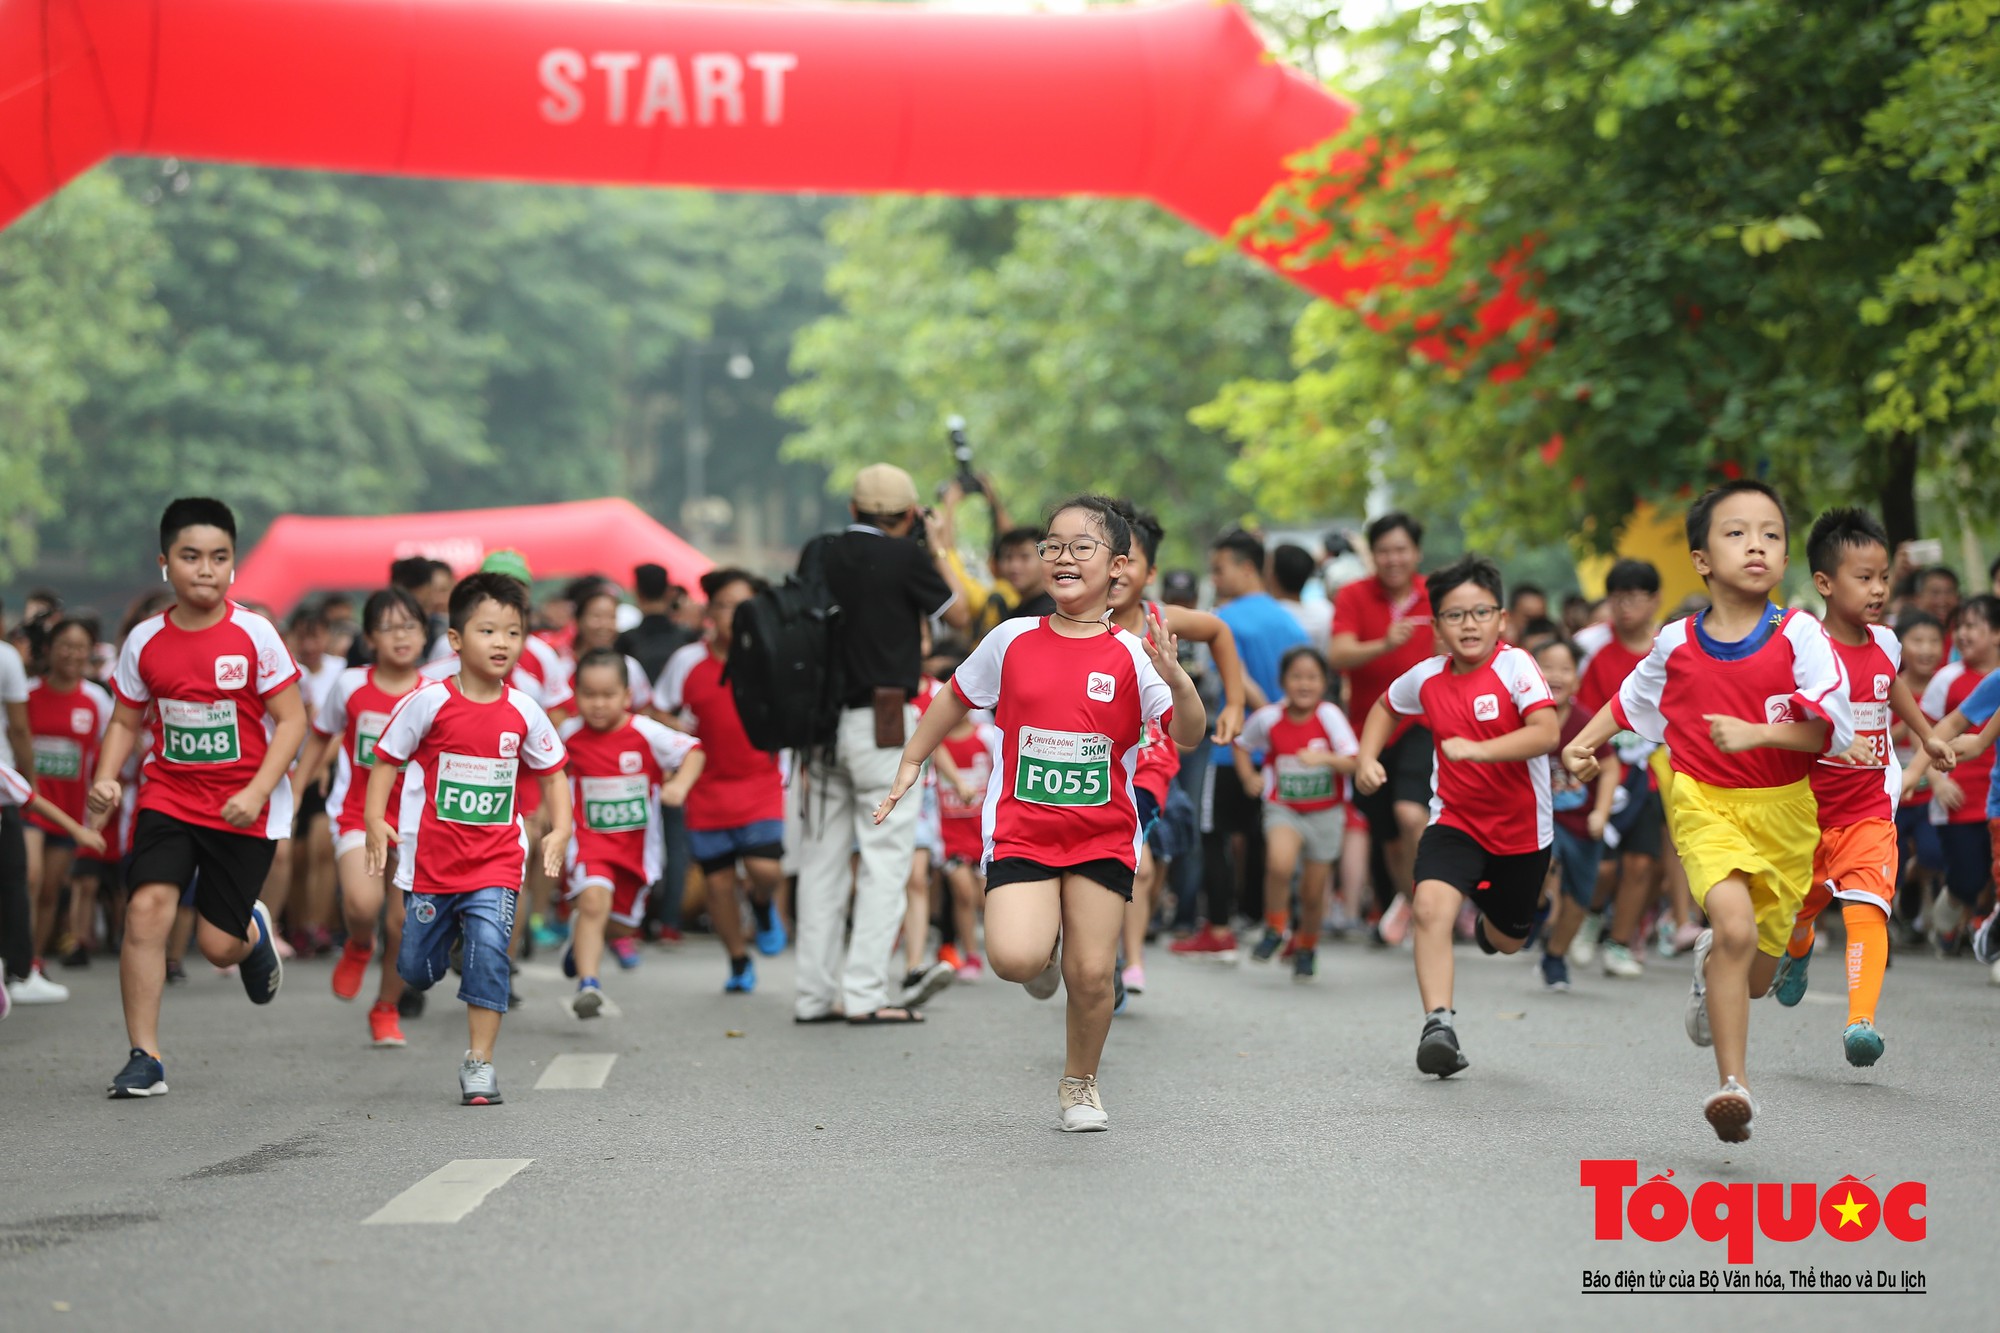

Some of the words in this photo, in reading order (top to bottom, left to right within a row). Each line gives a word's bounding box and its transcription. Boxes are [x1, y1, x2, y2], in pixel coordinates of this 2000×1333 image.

[538, 46, 798, 127] START
[218, 662, 245, 682] 24
[1089, 677, 1112, 696] 24
[1476, 700, 1496, 715] 24
[170, 729, 231, 755] F048
[1081, 744, 1107, 757] 3KM
[1026, 763, 1101, 795] F055
[443, 786, 508, 815] F087
